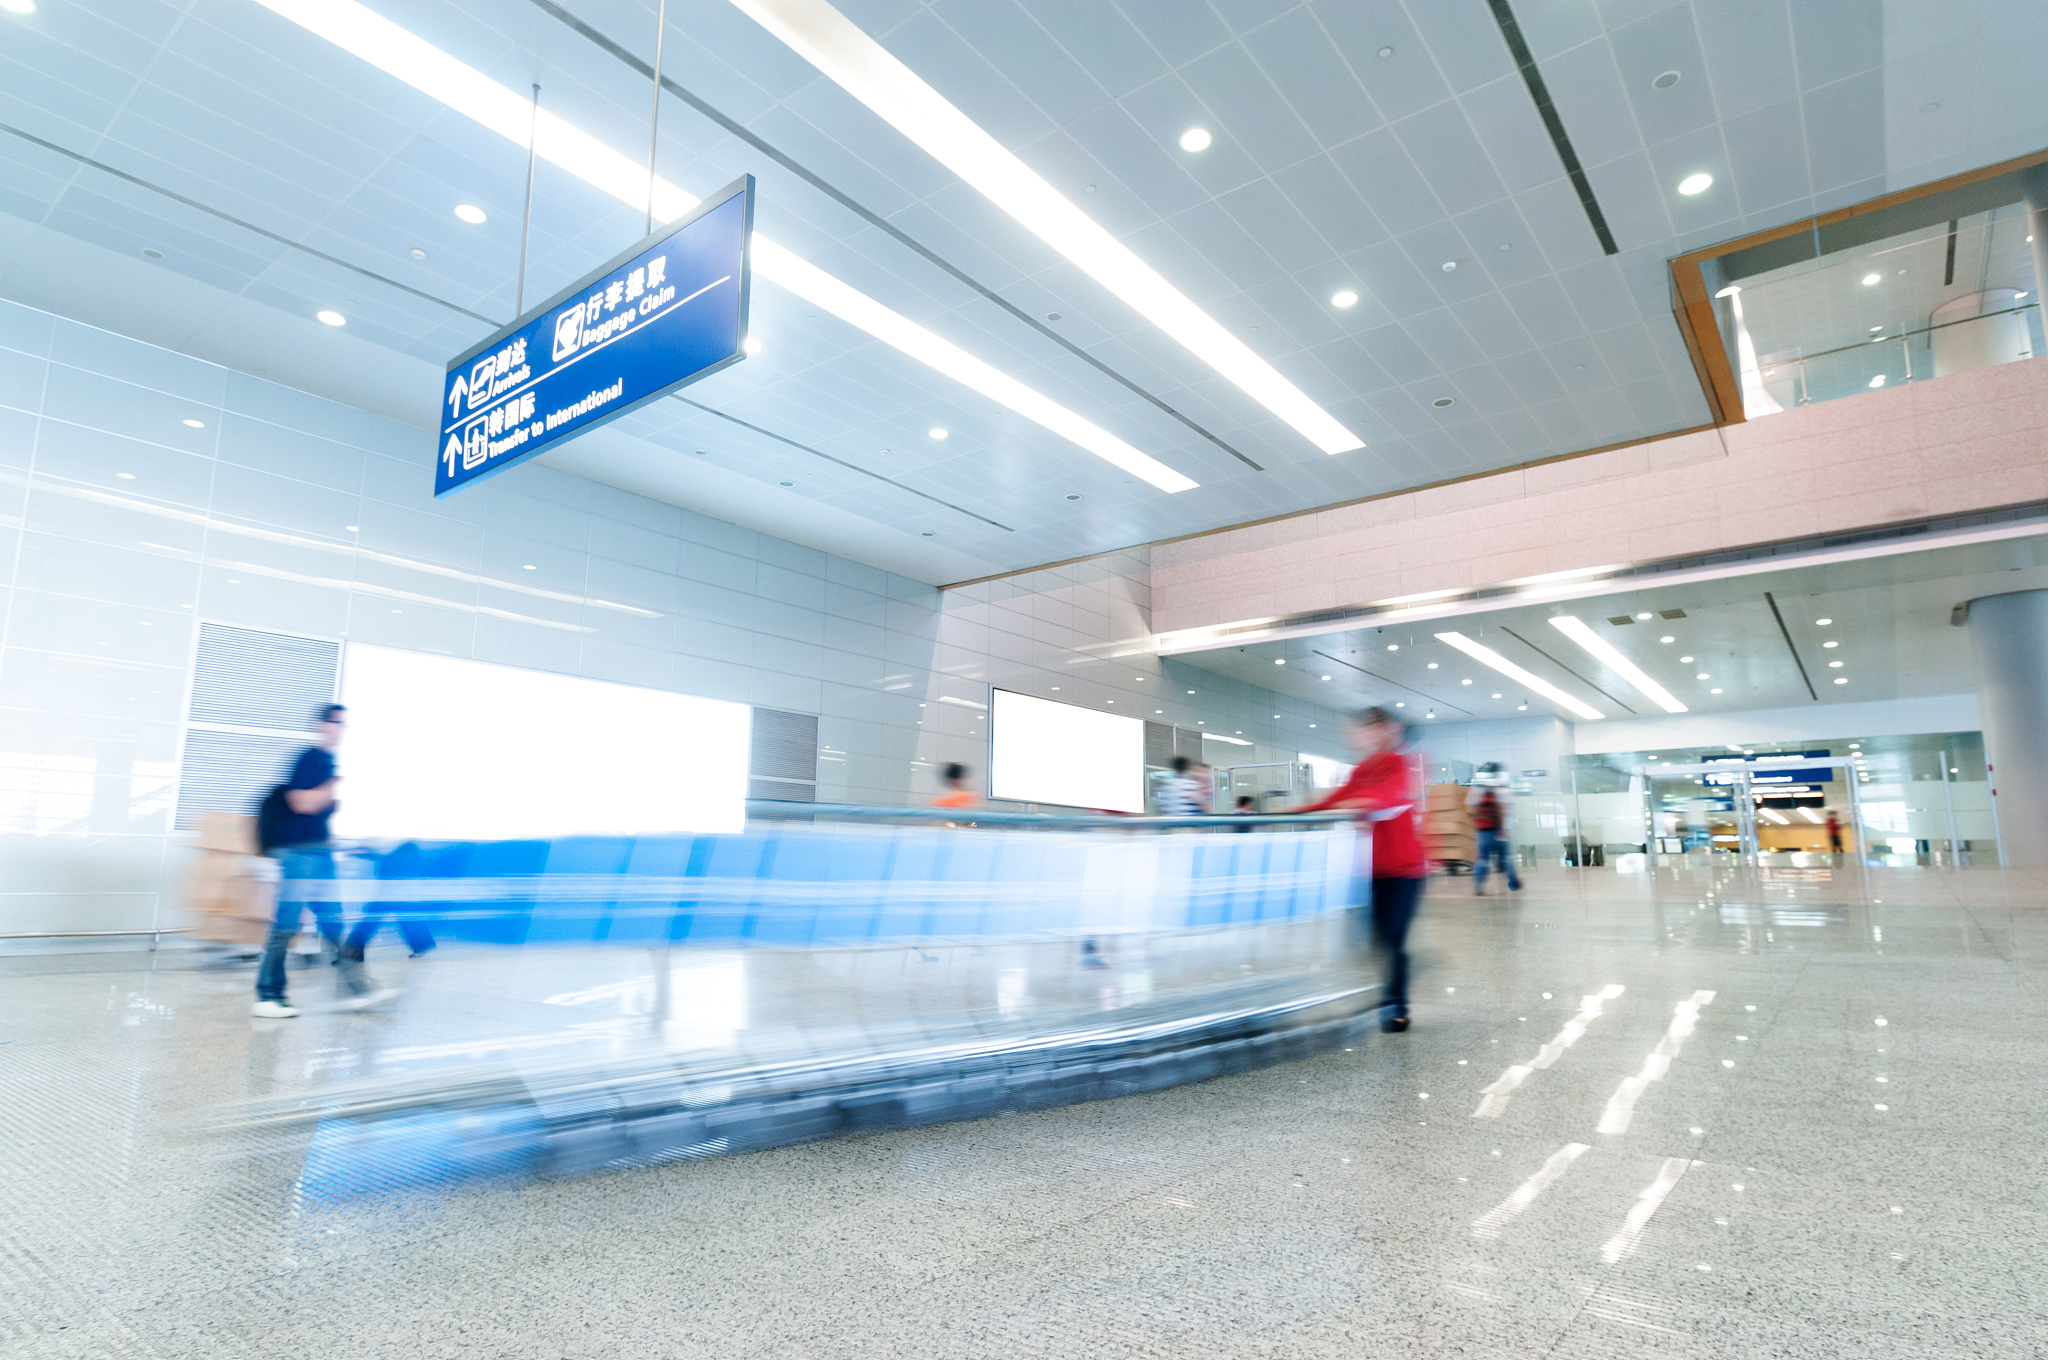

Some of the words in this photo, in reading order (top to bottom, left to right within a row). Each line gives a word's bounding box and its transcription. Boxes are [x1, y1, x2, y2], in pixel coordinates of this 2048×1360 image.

[582, 308, 637, 347] Baggage
[639, 285, 675, 315] Claim
[586, 255, 666, 325] 行李提取
[491, 364, 531, 397] Arrivals
[495, 337, 527, 376] 到达
[487, 428, 530, 459] Transfer
[531, 421, 544, 437] to
[546, 377, 623, 431] International
[489, 391, 536, 437] 转国际
